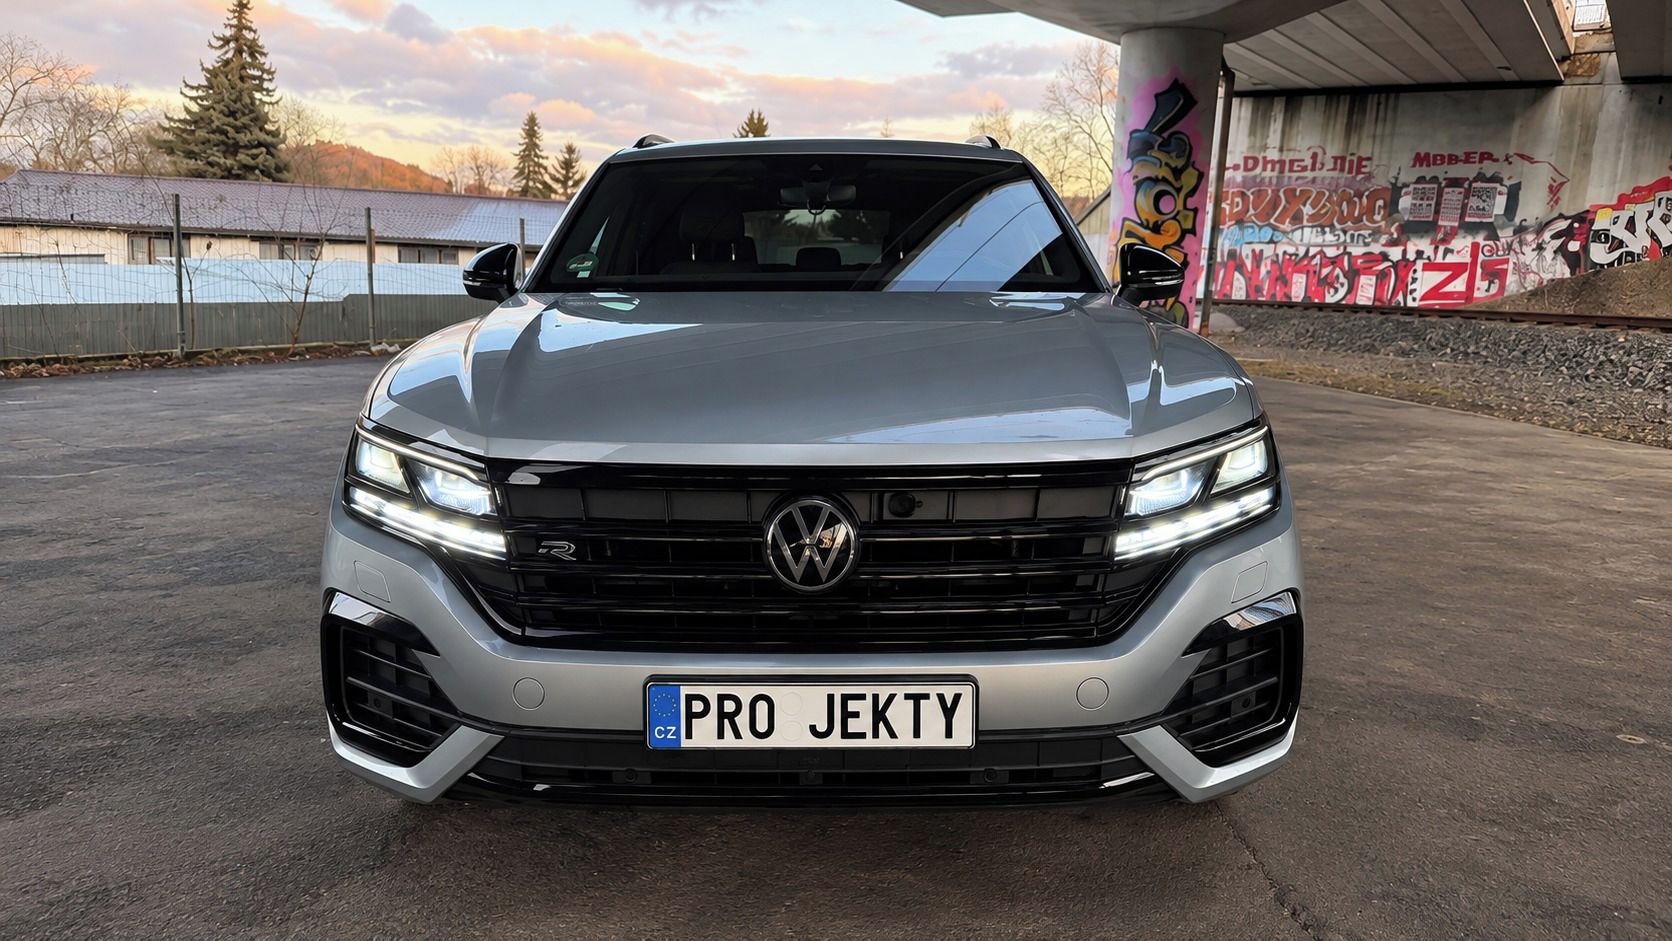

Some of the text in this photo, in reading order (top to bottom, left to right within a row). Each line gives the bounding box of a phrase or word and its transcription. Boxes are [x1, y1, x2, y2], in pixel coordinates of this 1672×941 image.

[538, 541, 577, 561] R
[770, 501, 852, 586] VW
[654, 726, 677, 739] CZ
[684, 693, 963, 740] PRO JEKTY
